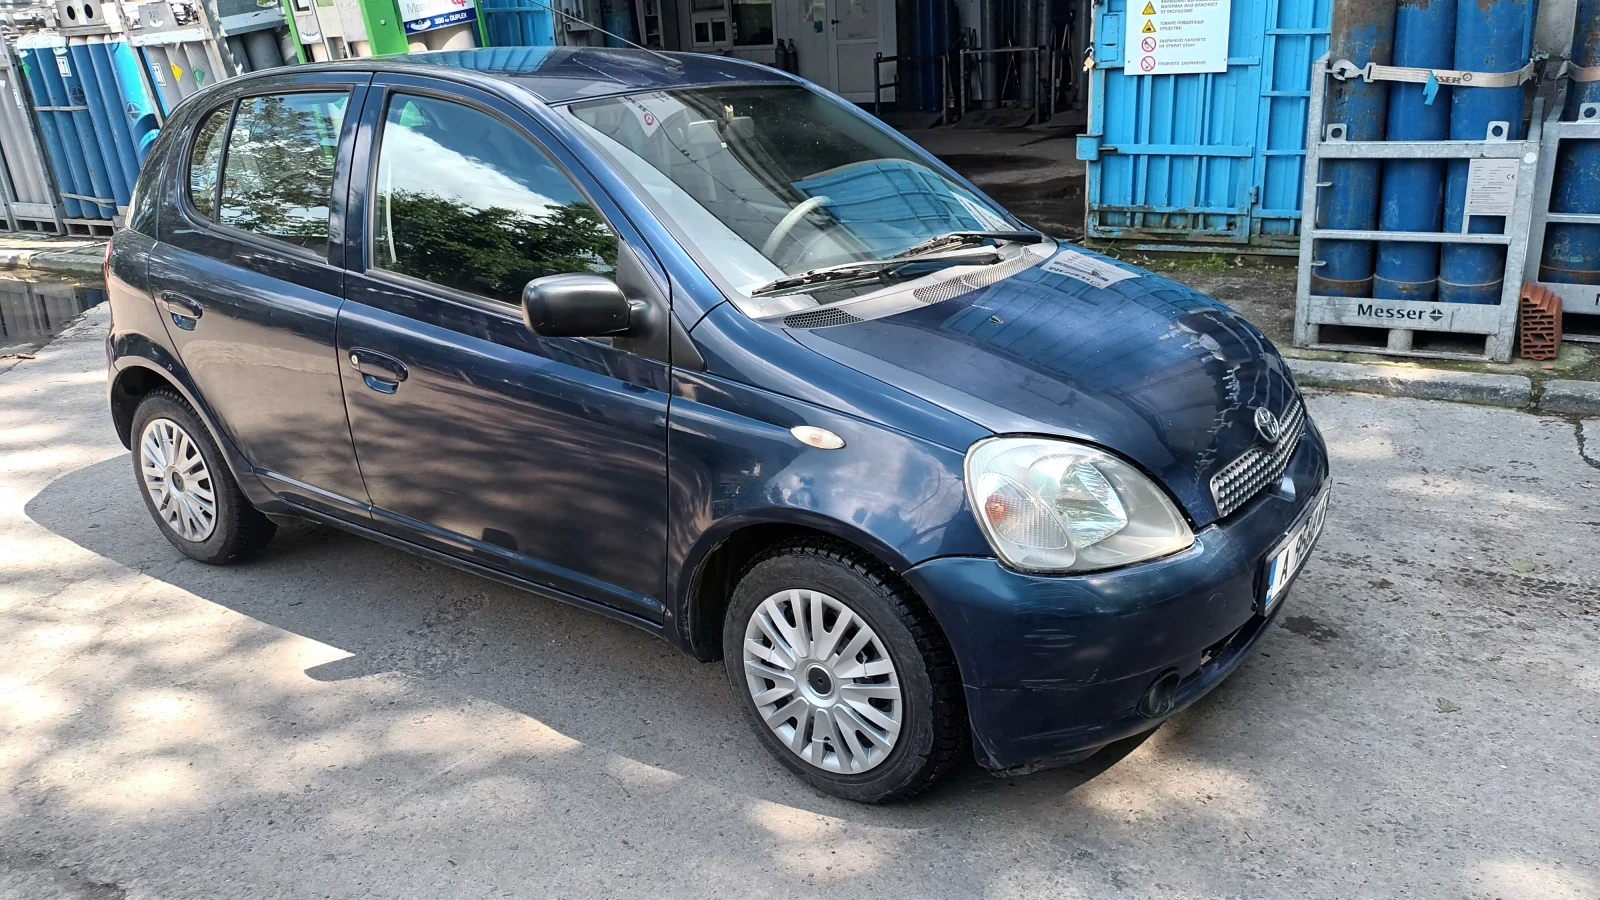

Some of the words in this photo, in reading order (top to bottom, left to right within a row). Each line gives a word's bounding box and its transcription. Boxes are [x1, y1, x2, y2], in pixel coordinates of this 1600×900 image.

[434, 17, 445, 25] 300
[449, 12, 468, 21] DUPLEX
[1435, 75, 1462, 84] SSER
[1357, 303, 1426, 320] Messer
